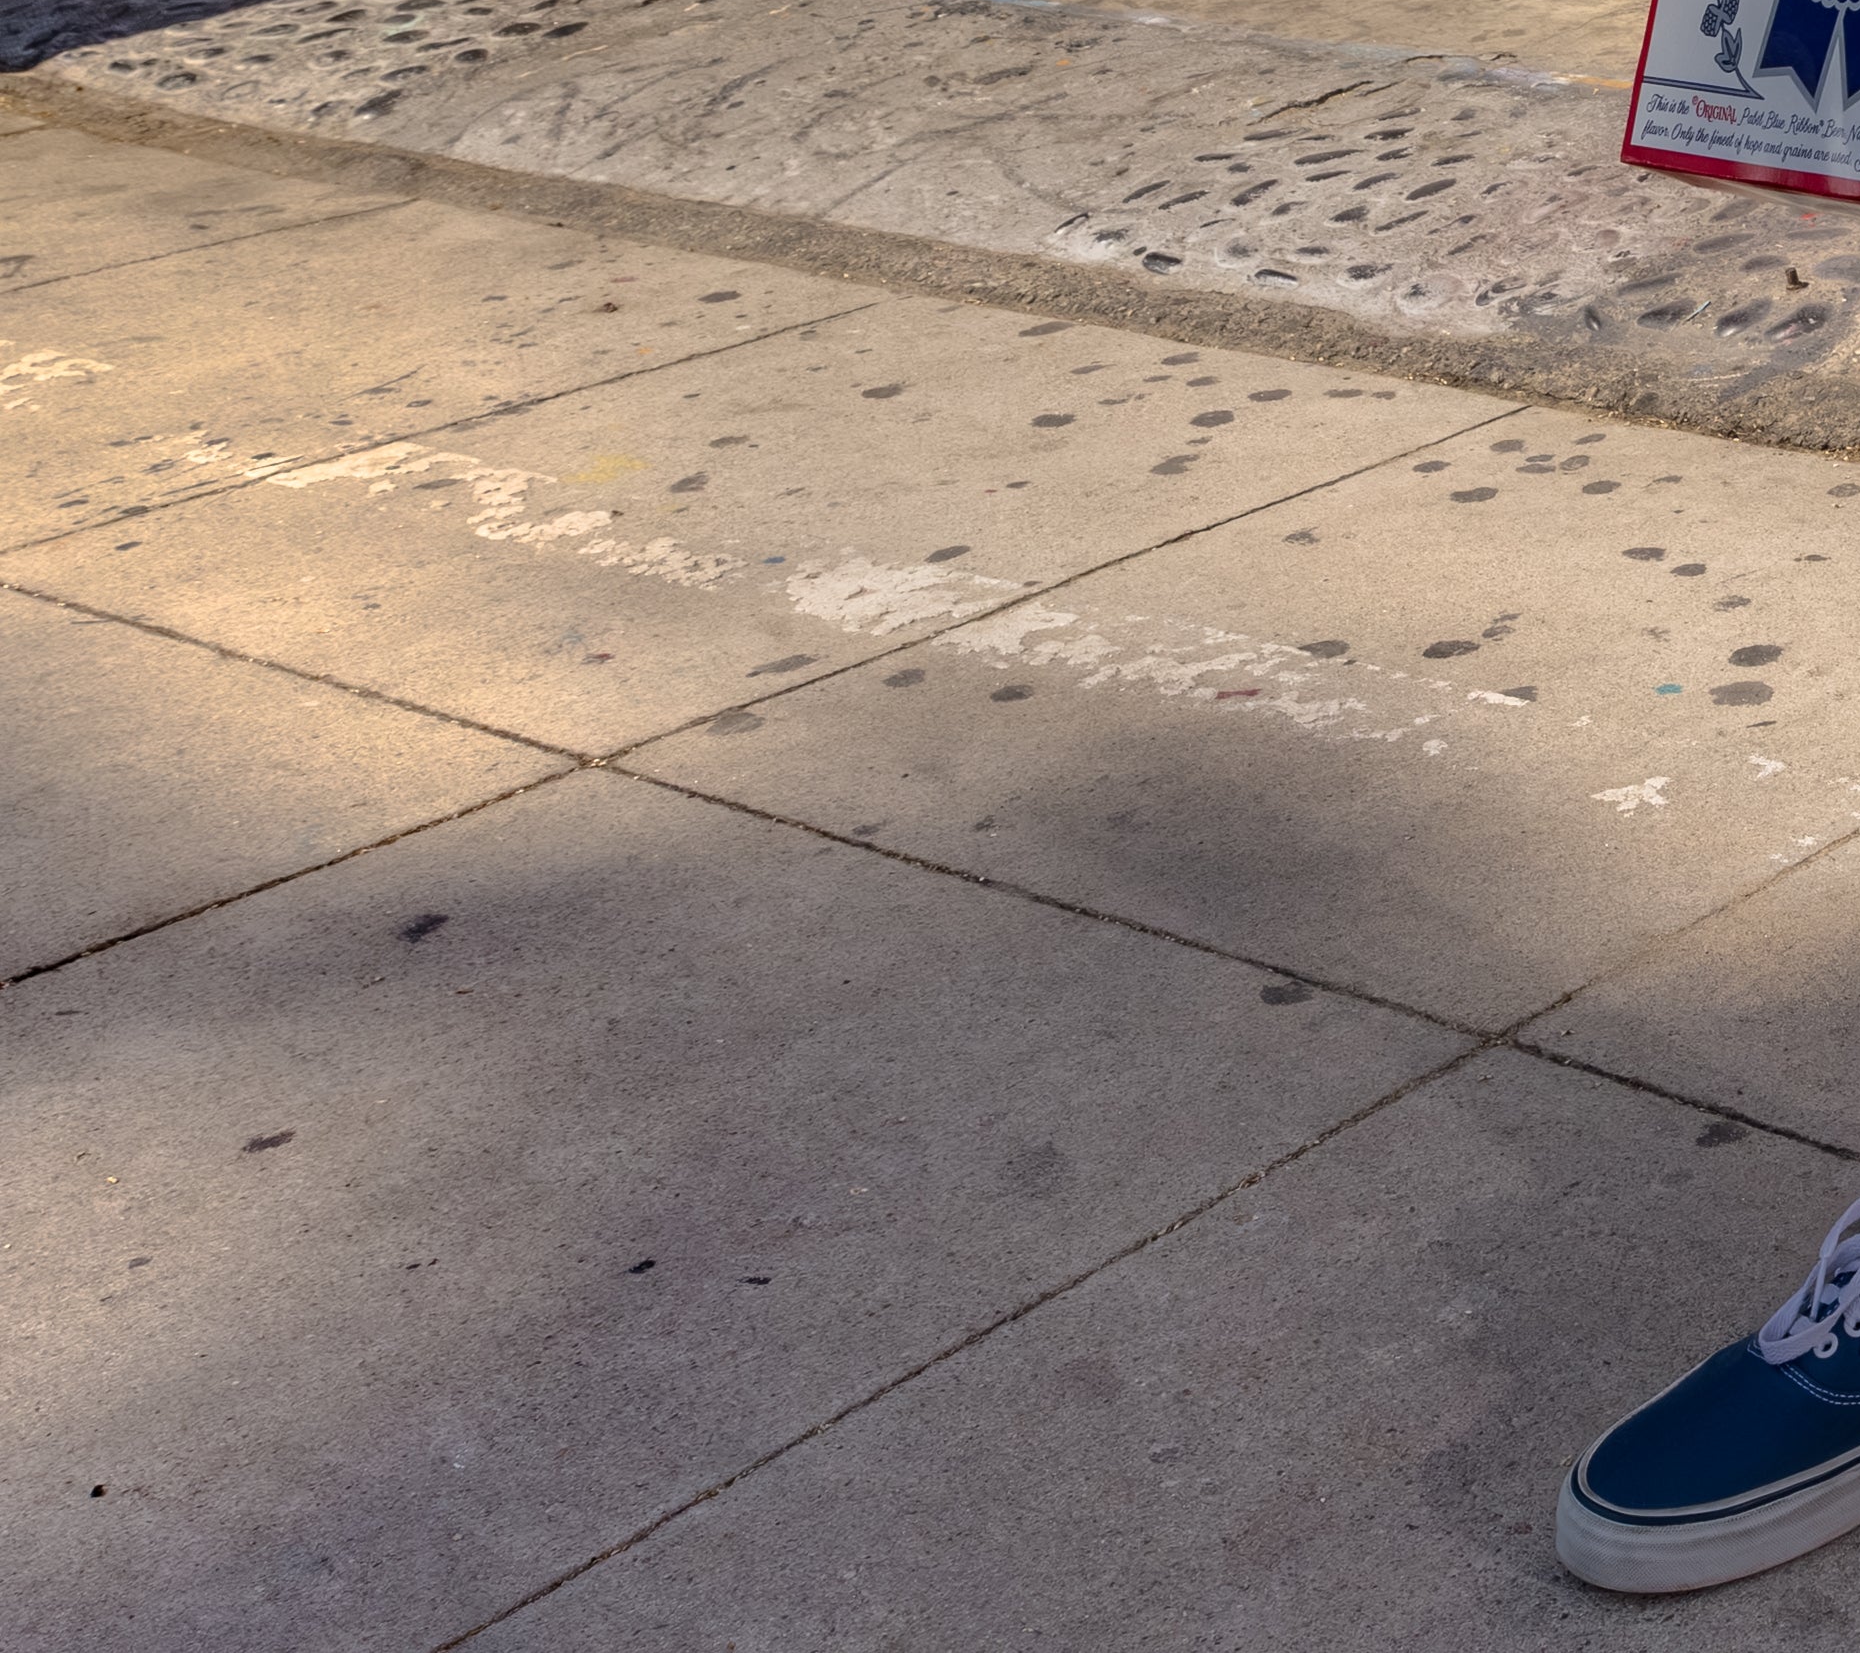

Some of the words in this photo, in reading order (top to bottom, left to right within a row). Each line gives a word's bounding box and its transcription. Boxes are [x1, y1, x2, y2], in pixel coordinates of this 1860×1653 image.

[1646, 93, 1669, 113] This
[1669, 100, 1676, 112] is
[1676, 100, 1690, 115] the
[1738, 107, 1763, 127] Pabst
[1762, 110, 1786, 130] Blue
[1670, 123, 1695, 147] Only
[1694, 128, 1709, 143] the
[1707, 130, 1735, 150] finest
[1734, 135, 1743, 155] of
[1743, 136, 1764, 156] hops
[1763, 141, 1783, 155] and
[1781, 143, 1813, 163] grains
[1813, 149, 1830, 161] are
